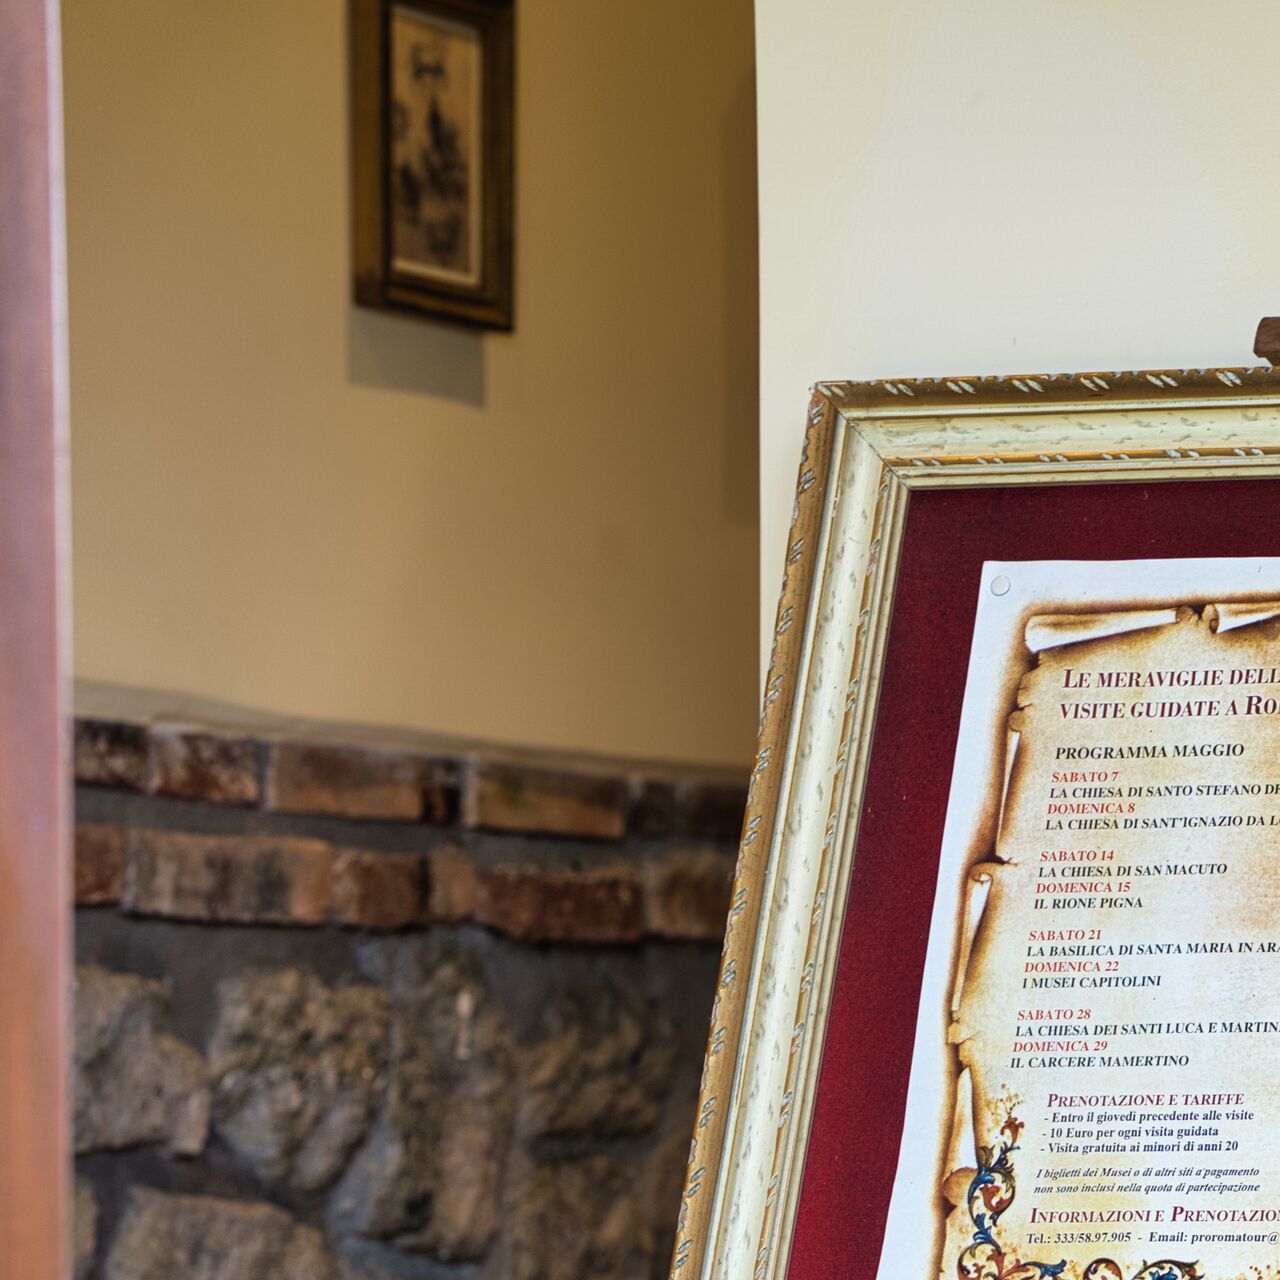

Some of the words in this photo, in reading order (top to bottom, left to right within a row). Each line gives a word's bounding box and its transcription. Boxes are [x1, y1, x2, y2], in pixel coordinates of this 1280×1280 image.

[1063, 669, 1091, 688] LE
[1096, 670, 1224, 688] MERAVIGLIE
[1060, 702, 1126, 719] VISITE
[1130, 700, 1220, 718] GUIDATE
[1224, 699, 1238, 716] A
[1055, 746, 1167, 760] PROGRAMMA
[1172, 743, 1245, 758] MAGGIO
[1051, 771, 1108, 783] SABATO
[1112, 771, 1119, 781] 7
[1050, 788, 1067, 799] LA
[1072, 787, 1123, 798] CHIESA
[1127, 787, 1143, 797] DI
[1145, 785, 1193, 797] SANTO
[1195, 784, 1261, 796] STEFANO
[1047, 803, 1123, 817] DOMENICA
[1127, 802, 1136, 813] 8
[1045, 820, 1063, 830] LA
[1068, 819, 1119, 830] CHIESA
[1123, 818, 1138, 829] DI
[1246, 816, 1265, 826] DA
[1040, 851, 1097, 862] SABATO
[1101, 850, 1114, 861] 14
[1038, 867, 1056, 878] LA
[1061, 866, 1112, 877] CHIESA
[1116, 866, 1132, 877] DI
[1134, 865, 1163, 876] SAN
[1165, 863, 1228, 875] MACUTO
[1036, 882, 1112, 894] DOMENICA
[1118, 881, 1131, 892] 15
[1034, 899, 1048, 910] IL
[1052, 897, 1097, 909] RIONE
[1100, 897, 1143, 909] PIGNA
[1028, 930, 1085, 941] SABATO
[1088, 929, 1101, 940] 21
[1027, 946, 1045, 957] LA
[1049, 945, 1114, 957] BASILICA
[1118, 944, 1134, 956] DI
[1136, 943, 1182, 955] SANTA
[1186, 942, 1233, 954] MARIA
[1238, 942, 1254, 953] IN
[1024, 961, 1101, 973] DOMENICA
[1105, 961, 1119, 972] 22
[1022, 978, 1028, 989] I
[1031, 977, 1076, 989] MUSEI
[1079, 975, 1162, 988] CAPITOLINI
[1017, 1009, 1074, 1020] SABATO
[1077, 1009, 1091, 1020] 28
[1015, 1026, 1033, 1037] LA
[1038, 1025, 1089, 1036] CHIESA
[1093, 1024, 1118, 1036] DEI
[1120, 1023, 1163, 1035] SANTI
[1166, 1022, 1204, 1034] LUCA
[1208, 1022, 1218, 1033] E
[1013, 1040, 1089, 1053] DOMENICA
[1093, 1041, 1108, 1051] 29
[1010, 1057, 1024, 1068] IL
[1028, 1056, 1096, 1068] CARCERE
[1099, 1055, 1189, 1067] MAMERTINO
[1047, 1093, 1165, 1108] PRENOTAZIONE
[1168, 1094, 1178, 1106] E
[1182, 1093, 1244, 1106] TARIFFE
[1052, 1112, 1084, 1123] Entro
[1086, 1112, 1094, 1122] il
[1138, 1110, 1200, 1124] precedente
[1202, 1110, 1222, 1121] alle
[1225, 1109, 1254, 1120] visite
[1050, 1128, 1063, 1138] 10
[1066, 1127, 1093, 1138] Euro
[1096, 1130, 1116, 1141] per
[1118, 1126, 1142, 1140] ogni
[1145, 1126, 1174, 1137] visita
[1176, 1125, 1219, 1140] guidata
[1048, 1142, 1079, 1153] Visita
[1082, 1142, 1126, 1155] gratuita
[1129, 1141, 1140, 1152] ai
[1143, 1141, 1181, 1152] minori
[1183, 1141, 1195, 1152] di
[1197, 1140, 1222, 1151] anni
[1225, 1140, 1239, 1151] 20
[1036, 1169, 1043, 1178] I
[1043, 1168, 1081, 1181] biglietti
[1082, 1167, 1099, 1177] dei
[1099, 1167, 1132, 1177] Musei
[1142, 1167, 1154, 1177] di
[1154, 1167, 1177, 1177] altri
[1178, 1167, 1194, 1177] siti
[1202, 1168, 1260, 1179] pagamento
[1081, 1183, 1116, 1192] inclusi
[1116, 1183, 1142, 1192] nella
[1144, 1184, 1173, 1195] quota
[1175, 1182, 1186, 1192] di
[1185, 1182, 1260, 1195] partecipazione
[1030, 1208, 1151, 1223] INFORMAZIONI
[1154, 1210, 1165, 1222] E
[1026, 1233, 1051, 1244] Tel.:
[1054, 1232, 1132, 1244] 333/58.97.905
[1149, 1231, 1188, 1242] Email:
